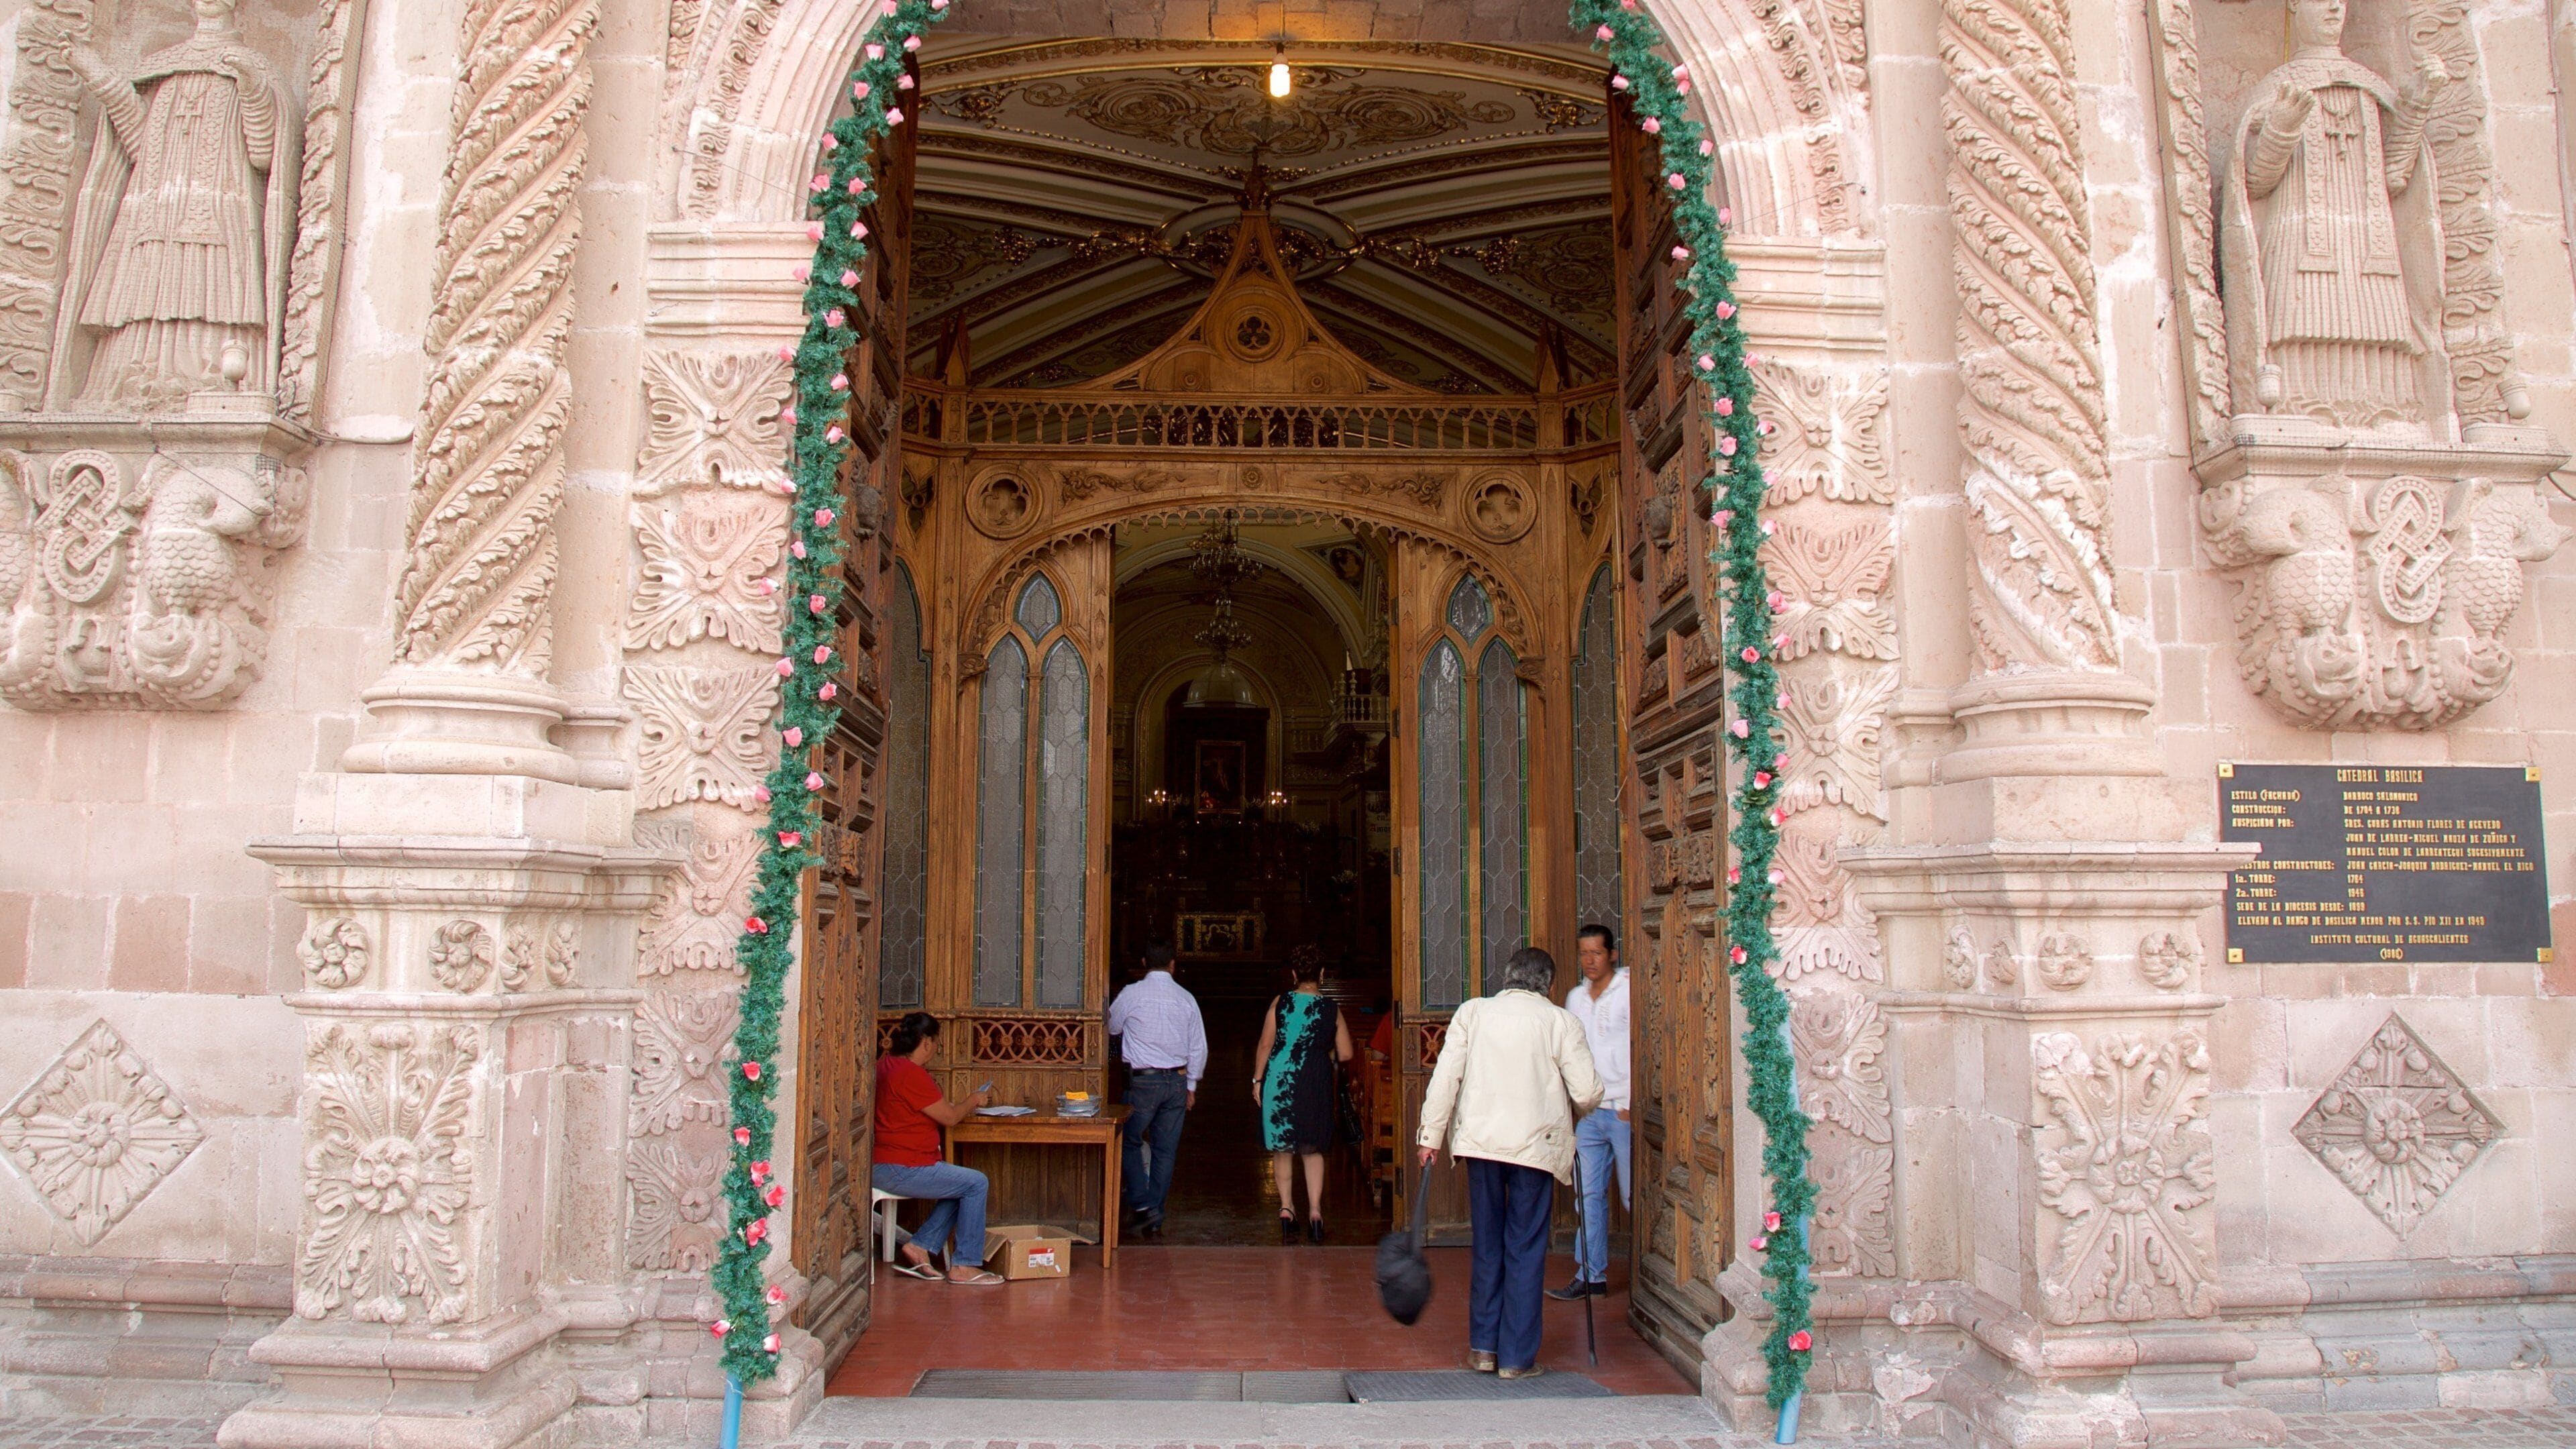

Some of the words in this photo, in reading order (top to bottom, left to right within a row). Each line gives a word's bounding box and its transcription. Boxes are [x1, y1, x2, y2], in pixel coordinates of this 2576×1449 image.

[2337, 769, 2379, 782] CATEDRAL
[2385, 769, 2423, 783] BASILICA
[2231, 790, 2257, 800] ESTILO
[2260, 789, 2300, 802] (FACHADA)
[2343, 791, 2374, 801] BARROCO
[2376, 791, 2418, 802] SALOMONICO
[2343, 805, 2353, 814] DE
[2356, 805, 2373, 815] 1704
[2375, 806, 2381, 815] A
[2277, 818, 2294, 828] POR:
[2344, 818, 2364, 828] SRES.
[2367, 819, 2390, 828] CURAS
[2392, 819, 2424, 828] ANTONIO
[2426, 819, 2453, 829] FLORES
[2456, 819, 2465, 829] DE
[2469, 820, 2501, 829] ACEVEDO
[2345, 833, 2363, 843] JUAN
[2367, 833, 2376, 843] DE
[2470, 835, 2479, 844] DE
[2510, 835, 2516, 844] Y
[2346, 847, 2375, 857] MANUEL
[2377, 847, 2400, 857] COLON
[2403, 847, 2412, 857] DE
[2467, 847, 2525, 857] SUCESIVAMENTE
[2236, 860, 2271, 870] ESTROS
[2273, 860, 2335, 870] CONSTRUCTORES:
[2347, 860, 2365, 870] JUAN
[2504, 862, 2513, 871] EL
[2517, 862, 2534, 871] RICO
[2235, 873, 2247, 883] 1a.
[2248, 873, 2275, 883] TORRE:
[2235, 888, 2249, 898] 2a.
[2250, 888, 2277, 898] TORRE:
[2236, 902, 2255, 911] SEDE
[2257, 902, 2267, 911] DE
[2271, 902, 2281, 912] LA
[2284, 902, 2317, 912] DIOCESIS
[2320, 902, 2345, 912] DESDE:
[2237, 916, 2269, 925] ELEVADA
[2273, 916, 2282, 926] AL
[2286, 916, 2308, 926] RANGO
[2312, 916, 2321, 926] DE
[2324, 916, 2357, 926] BASILICA
[2360, 916, 2383, 926] MENOR
[2387, 916, 2402, 926] POR
[2424, 916, 2436, 926] PIO
[2439, 916, 2451, 926] XII
[2455, 916, 2464, 926] EN
[2310, 934, 2351, 944] INSTITUTO
[2355, 934, 2391, 944] CULTURAL
[2394, 934, 2404, 944] DE
[2408, 934, 2469, 944] AGUASCALIENTES
